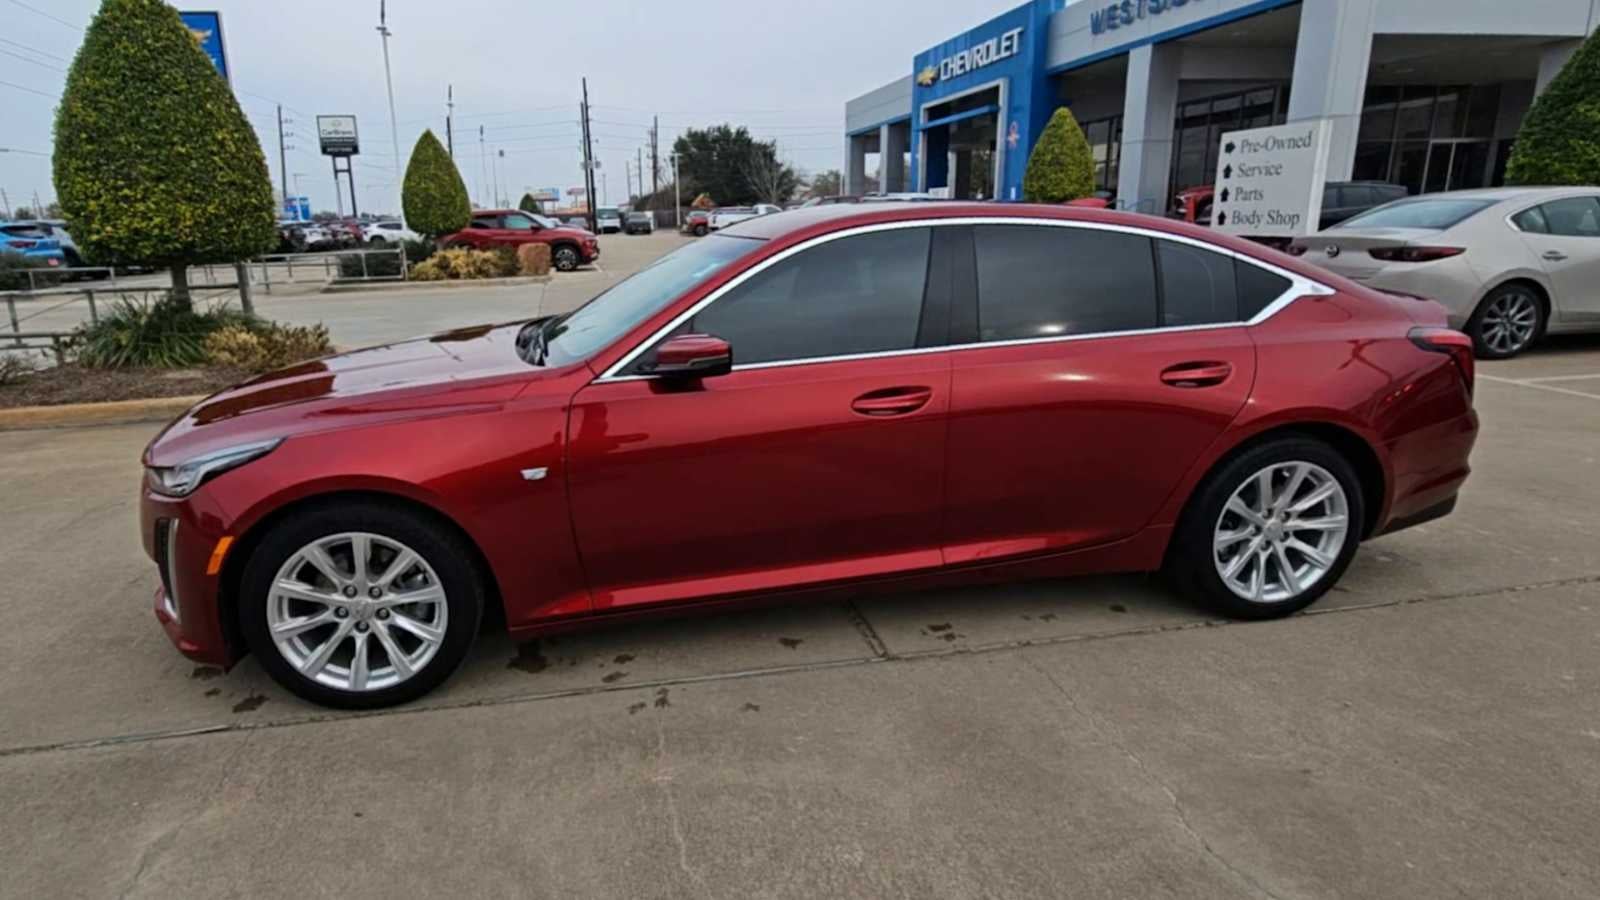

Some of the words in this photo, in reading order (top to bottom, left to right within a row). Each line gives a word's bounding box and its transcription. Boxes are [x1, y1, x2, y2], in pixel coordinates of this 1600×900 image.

[940, 26, 1024, 80] CHEVROLET
[1240, 131, 1312, 153] Pre-Owned
[1237, 162, 1283, 178] Service
[1234, 187, 1264, 201] Parts
[1231, 210, 1262, 229] Body
[1266, 209, 1300, 229] Shop
